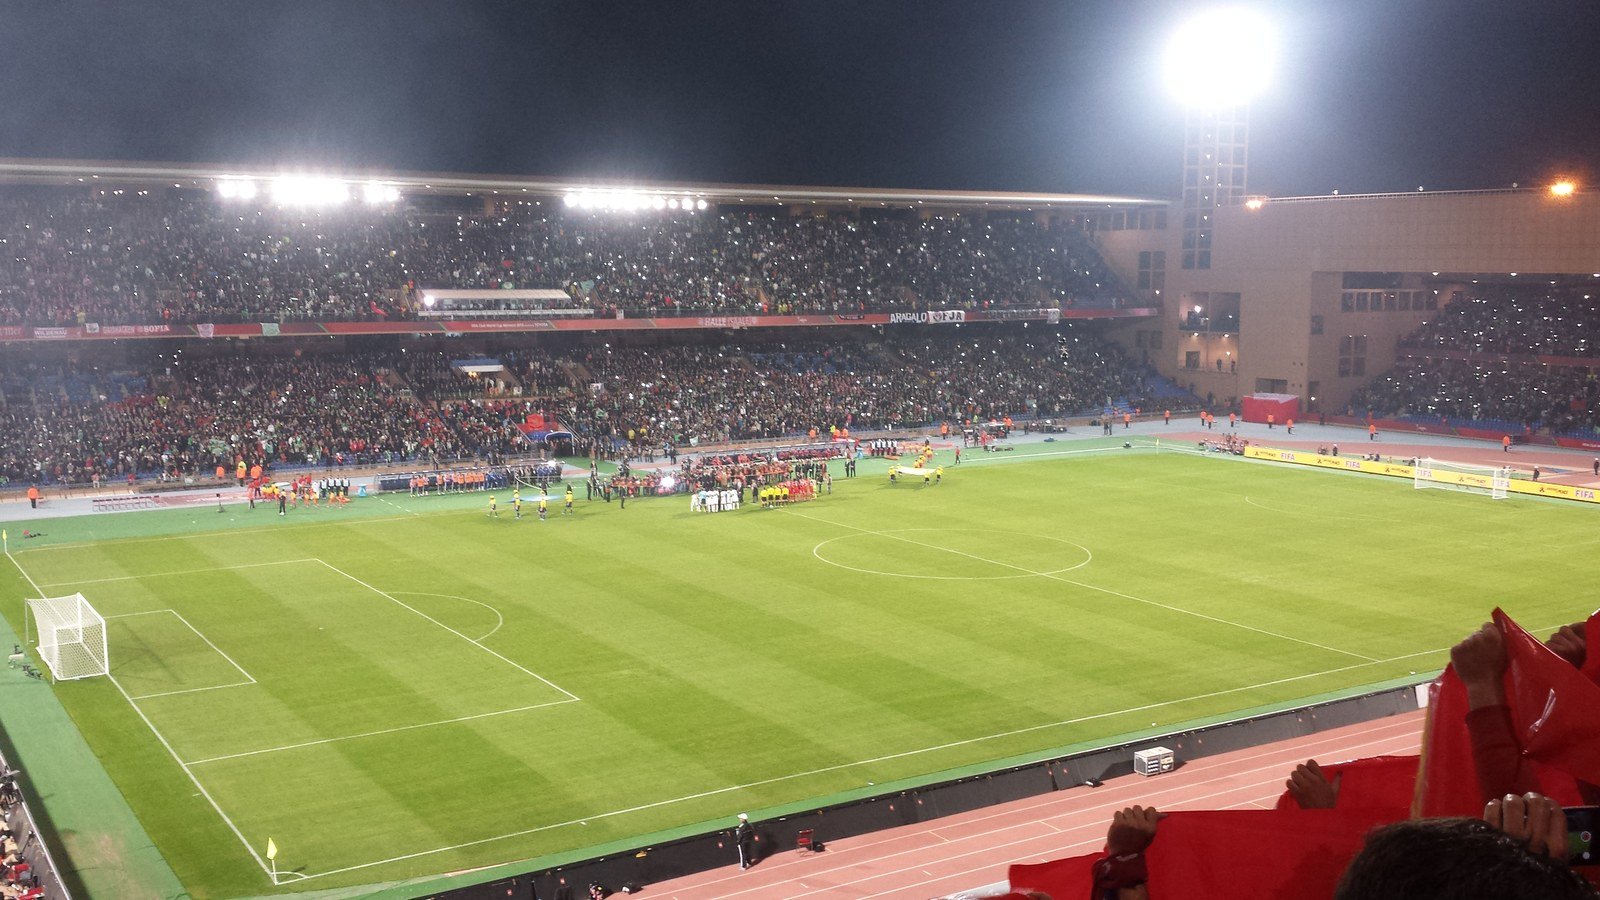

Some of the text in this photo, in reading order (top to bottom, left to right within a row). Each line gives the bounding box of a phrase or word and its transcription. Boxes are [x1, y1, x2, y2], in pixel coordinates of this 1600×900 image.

[704, 317, 727, 326] HALLE
[890, 312, 927, 324] ARAGALO
[143, 324, 170, 333] SOFIA
[1280, 452, 1295, 461] FIFA
[1345, 460, 1361, 469] FIFA
[1416, 469, 1432, 478] FIFA
[1492, 479, 1510, 488] FIFA
[1575, 489, 1594, 499] FIFA
